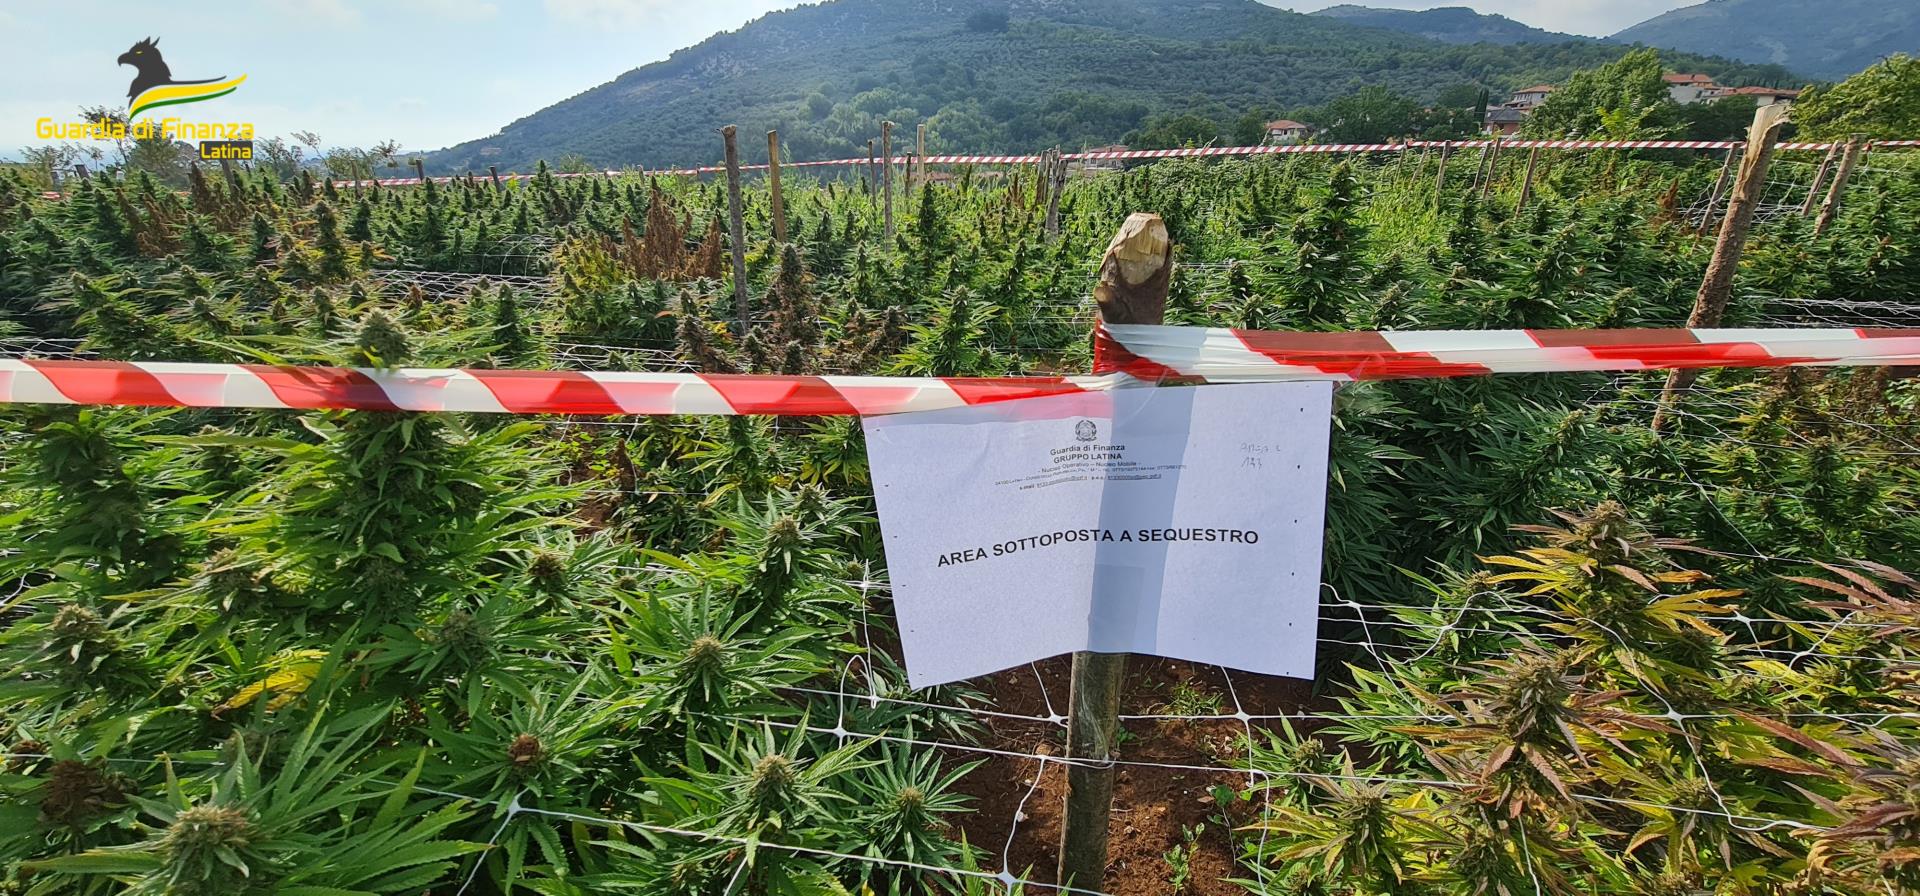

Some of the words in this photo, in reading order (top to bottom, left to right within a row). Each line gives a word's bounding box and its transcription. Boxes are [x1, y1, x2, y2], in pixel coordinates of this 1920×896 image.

[1050, 445, 1081, 455] Guardia
[1053, 454, 1089, 463] GRUPPO
[937, 547, 988, 568] AREA
[993, 529, 1114, 556] SOTTOPOSTA
[1120, 530, 1133, 542] A
[1138, 528, 1259, 544] SEQUESTRO
